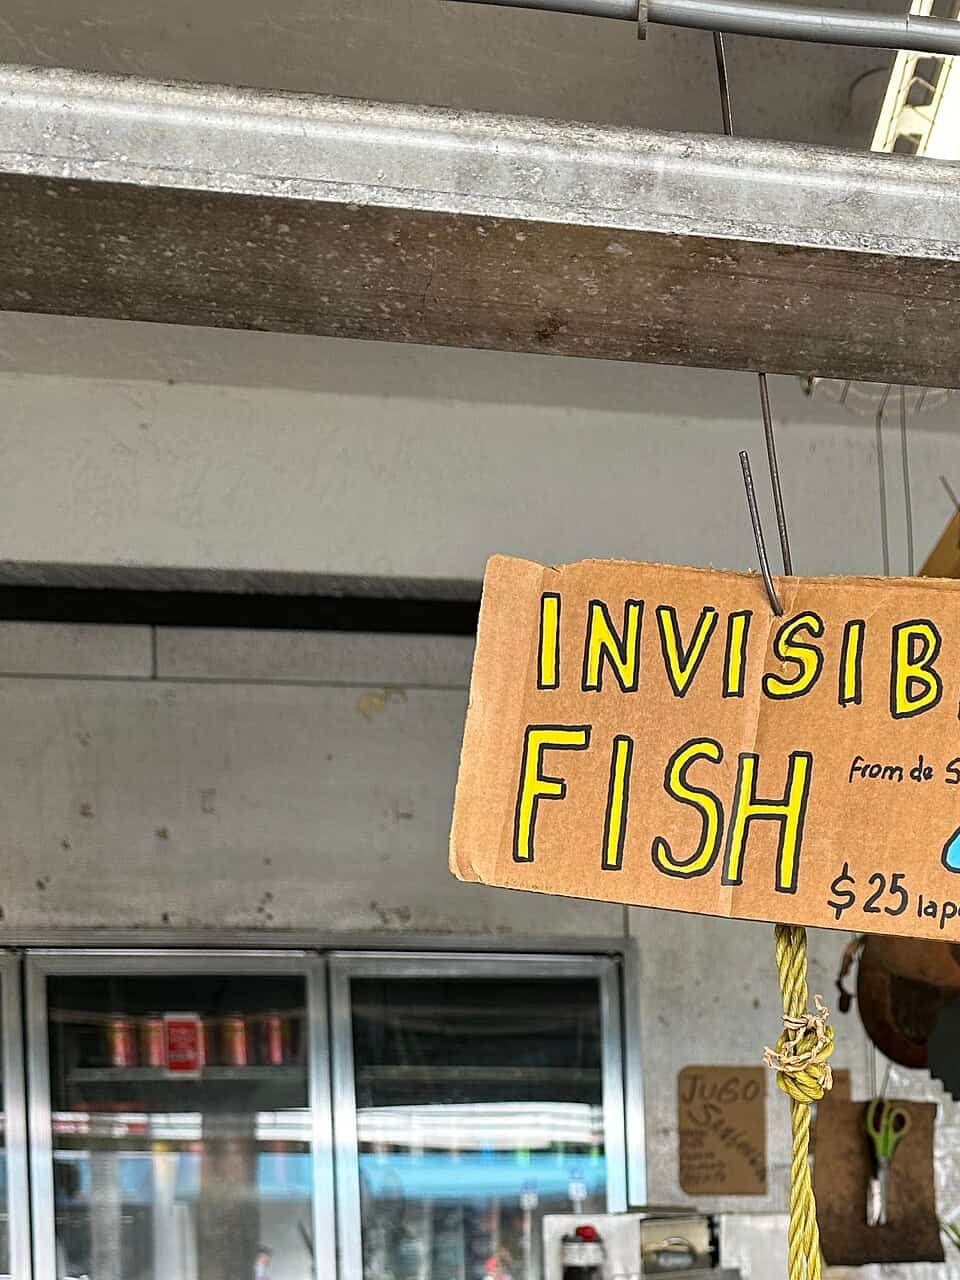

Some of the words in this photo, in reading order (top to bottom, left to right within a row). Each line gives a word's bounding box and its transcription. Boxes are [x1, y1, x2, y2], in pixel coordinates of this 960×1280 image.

[849, 755, 904, 783] from
[909, 755, 934, 782] de
[512, 724, 813, 894] FISH
[828, 862, 909, 922] $25
